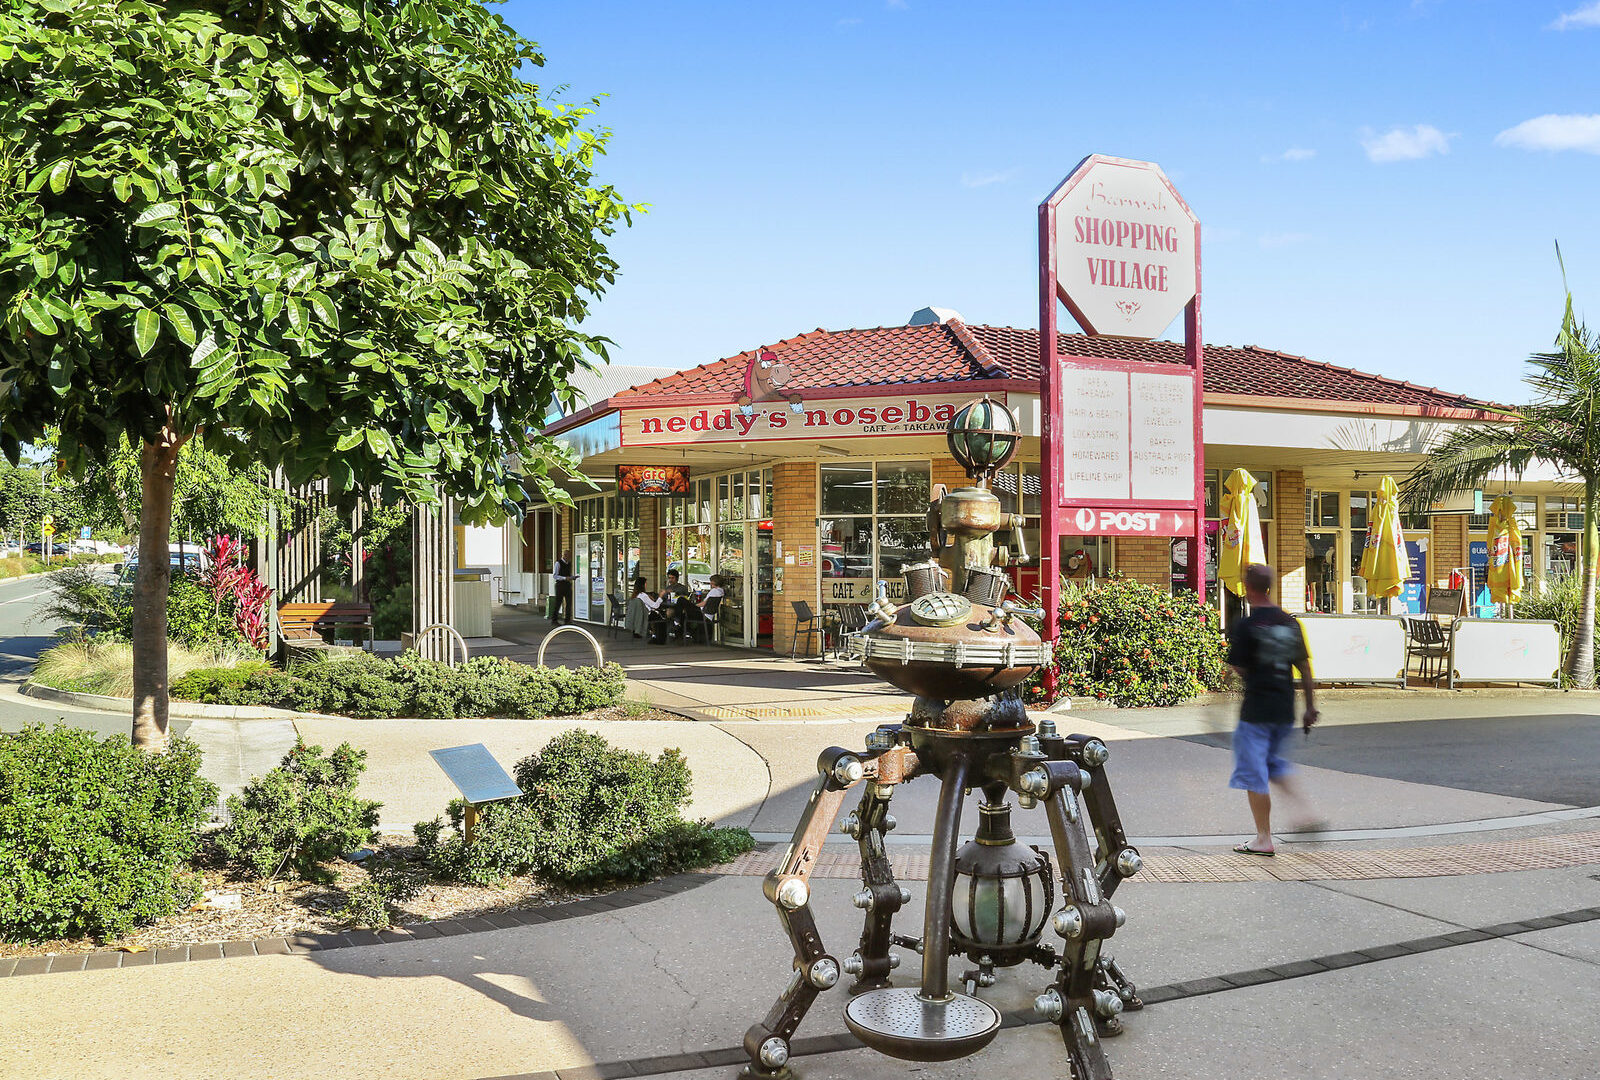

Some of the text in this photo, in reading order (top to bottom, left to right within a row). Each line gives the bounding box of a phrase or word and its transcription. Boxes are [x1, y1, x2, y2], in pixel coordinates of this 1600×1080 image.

[1074, 215, 1178, 253] SHOPPING
[1086, 257, 1168, 292] VILLAGE
[640, 399, 957, 437] neddy's noseba
[863, 424, 887, 433] CAFE
[903, 422, 950, 432] TAKEAW
[1072, 450, 1120, 461] HOMEWARES
[643, 469, 667, 481] GFC
[1070, 471, 1101, 481] LIFELINE
[1100, 512, 1160, 531] POST
[832, 582, 855, 599] CAFE
